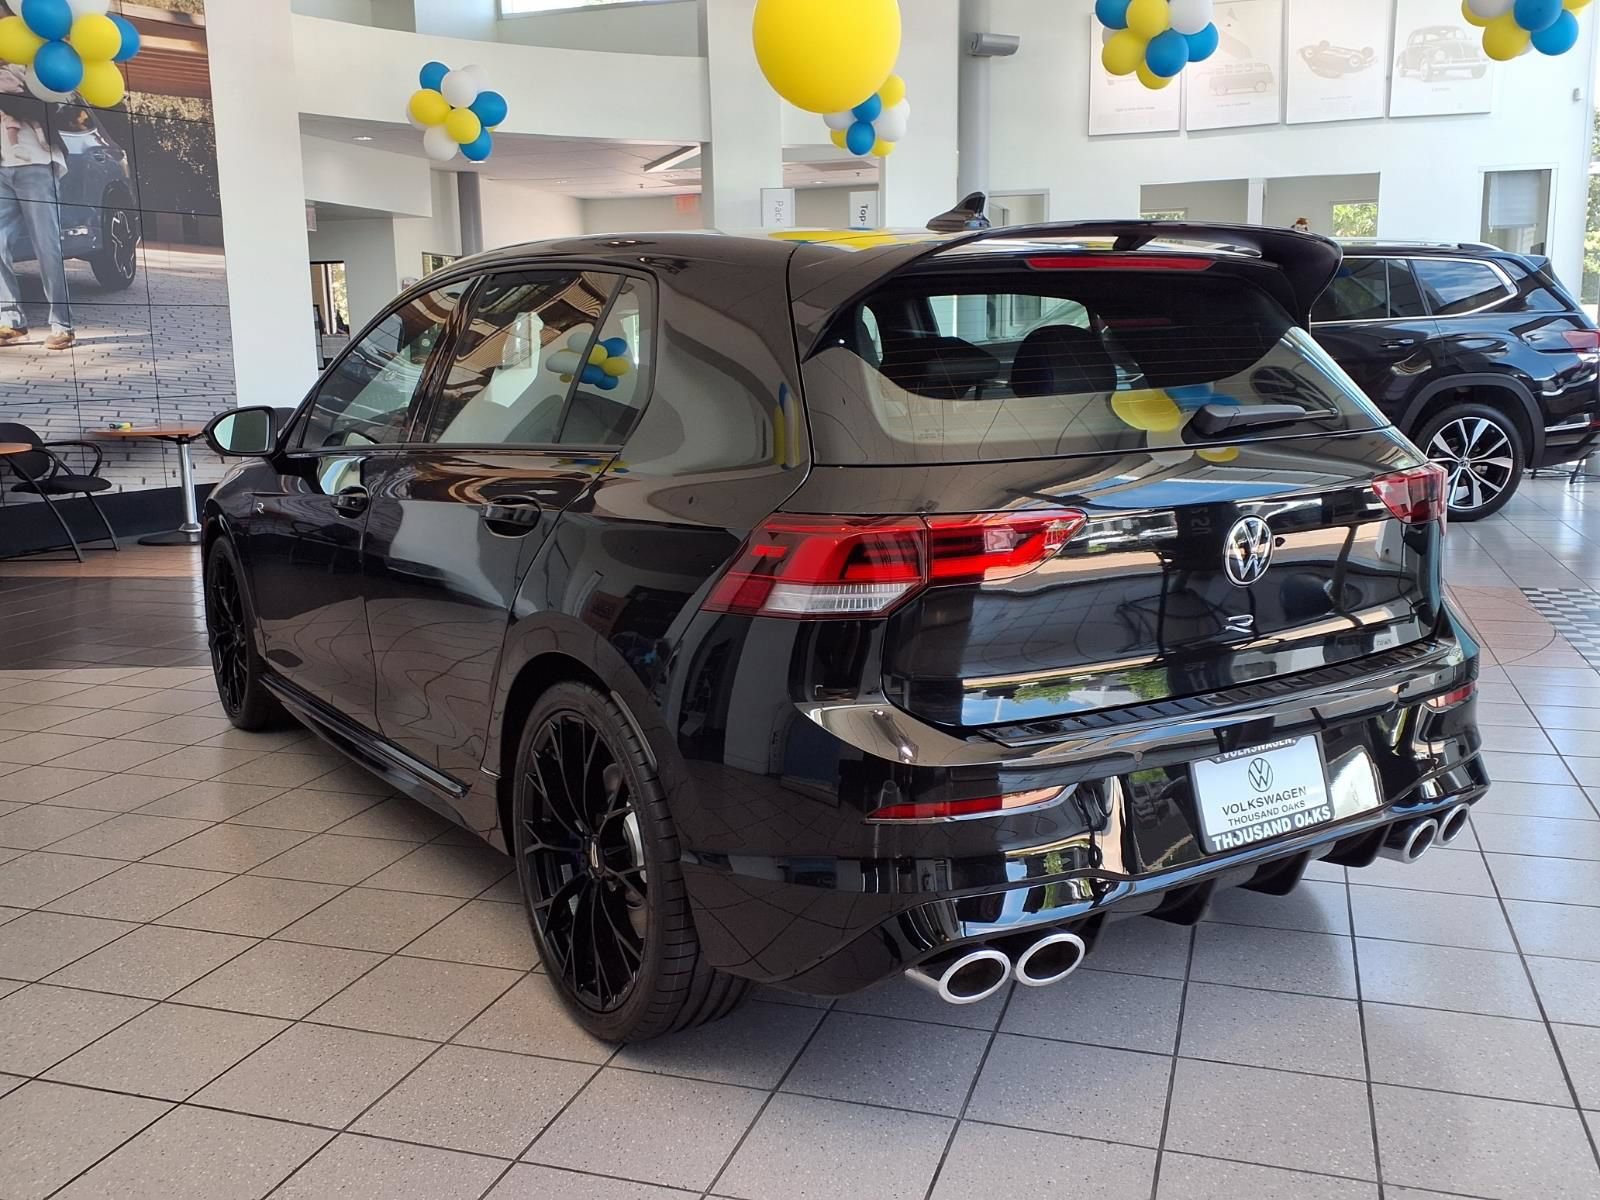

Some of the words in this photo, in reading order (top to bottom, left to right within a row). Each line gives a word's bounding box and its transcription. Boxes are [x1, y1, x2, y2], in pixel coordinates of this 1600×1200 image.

[1221, 786, 1307, 816] VOLKSWAGEN
[1228, 807, 1280, 827] THOUSAND
[1281, 800, 1306, 813] OAKS
[1211, 817, 1291, 851] THOUSAND
[1294, 805, 1331, 828] OAKS
